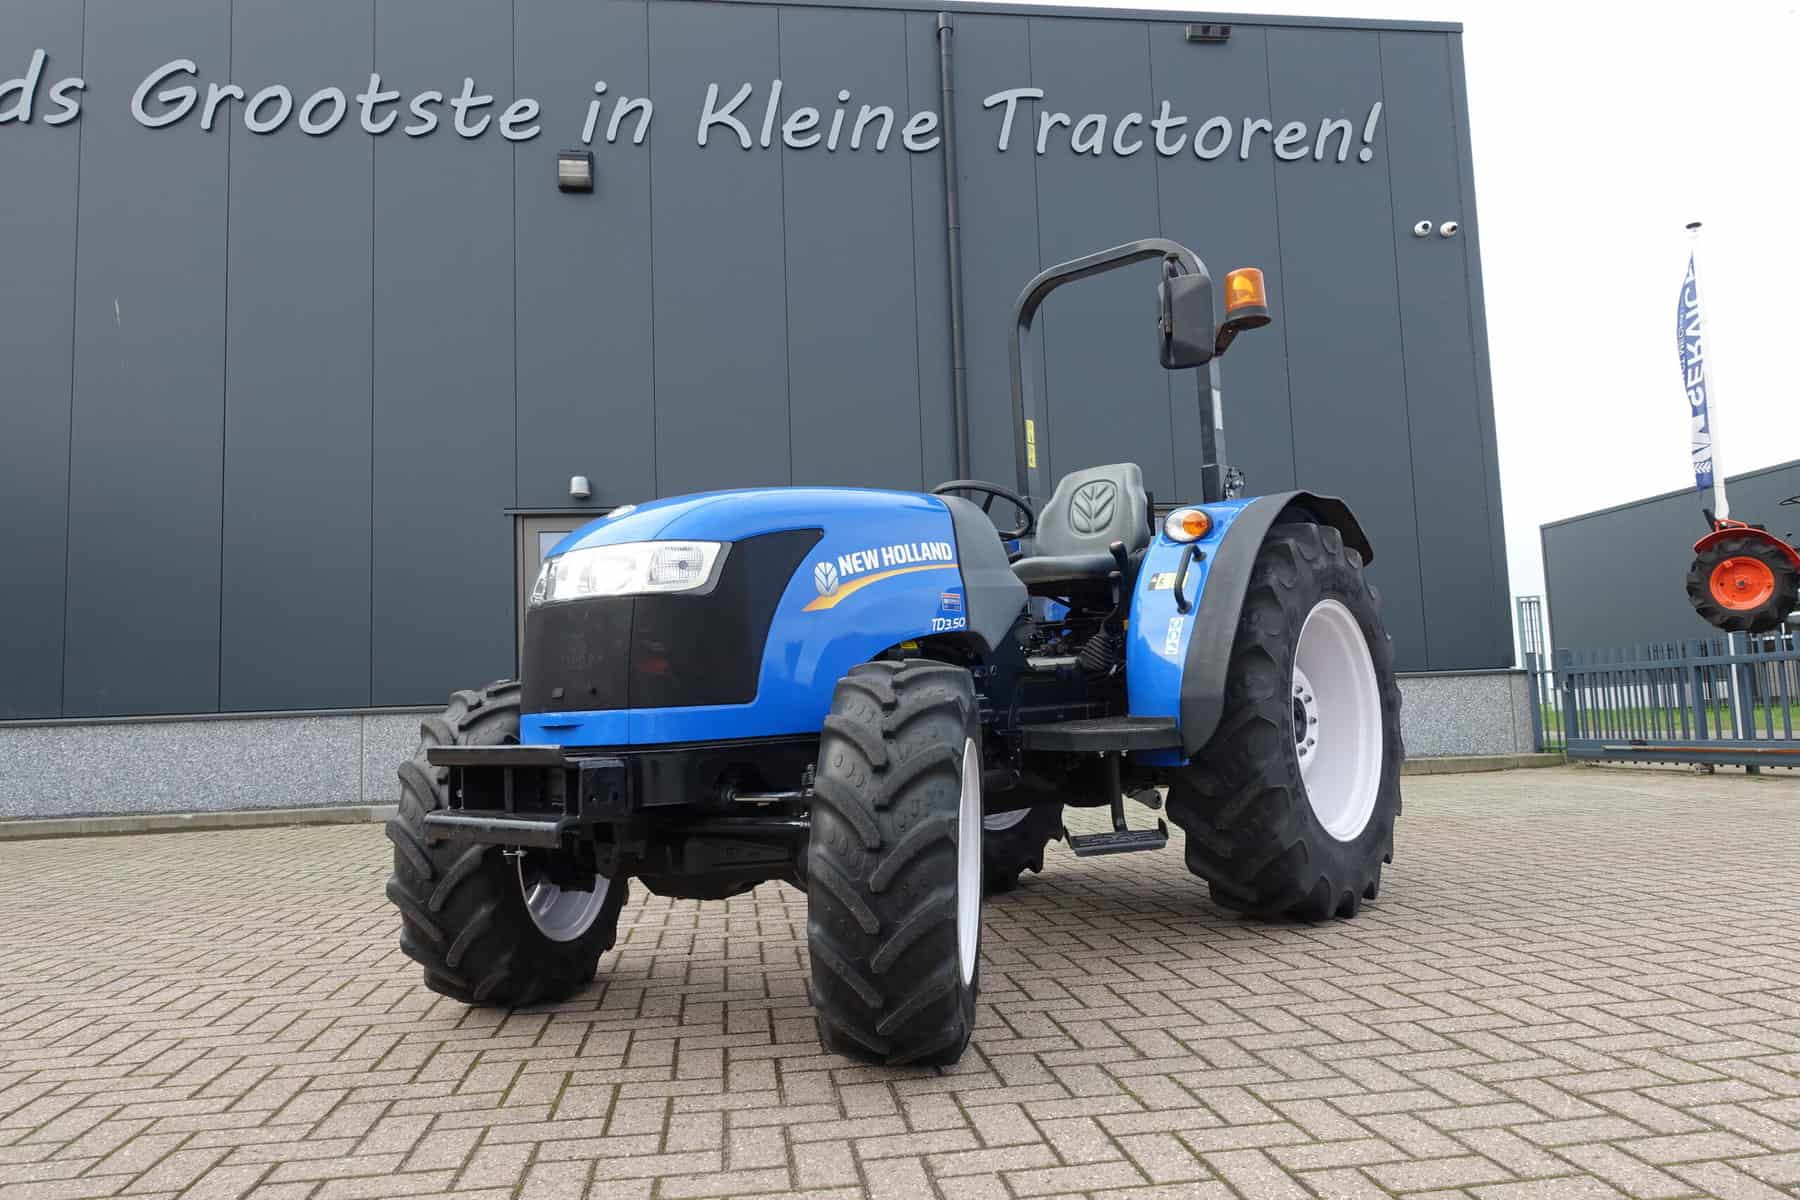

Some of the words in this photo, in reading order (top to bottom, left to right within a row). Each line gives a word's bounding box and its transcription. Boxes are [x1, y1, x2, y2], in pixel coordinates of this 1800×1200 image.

[131, 59, 541, 140] Grootste
[582, 81, 653, 143] in
[697, 80, 940, 151] Kleine
[984, 88, 1383, 162] Tractoren!
[838, 549, 880, 576] NEW
[881, 542, 953, 567] HOLLAND
[931, 617, 966, 632] TD3.50
